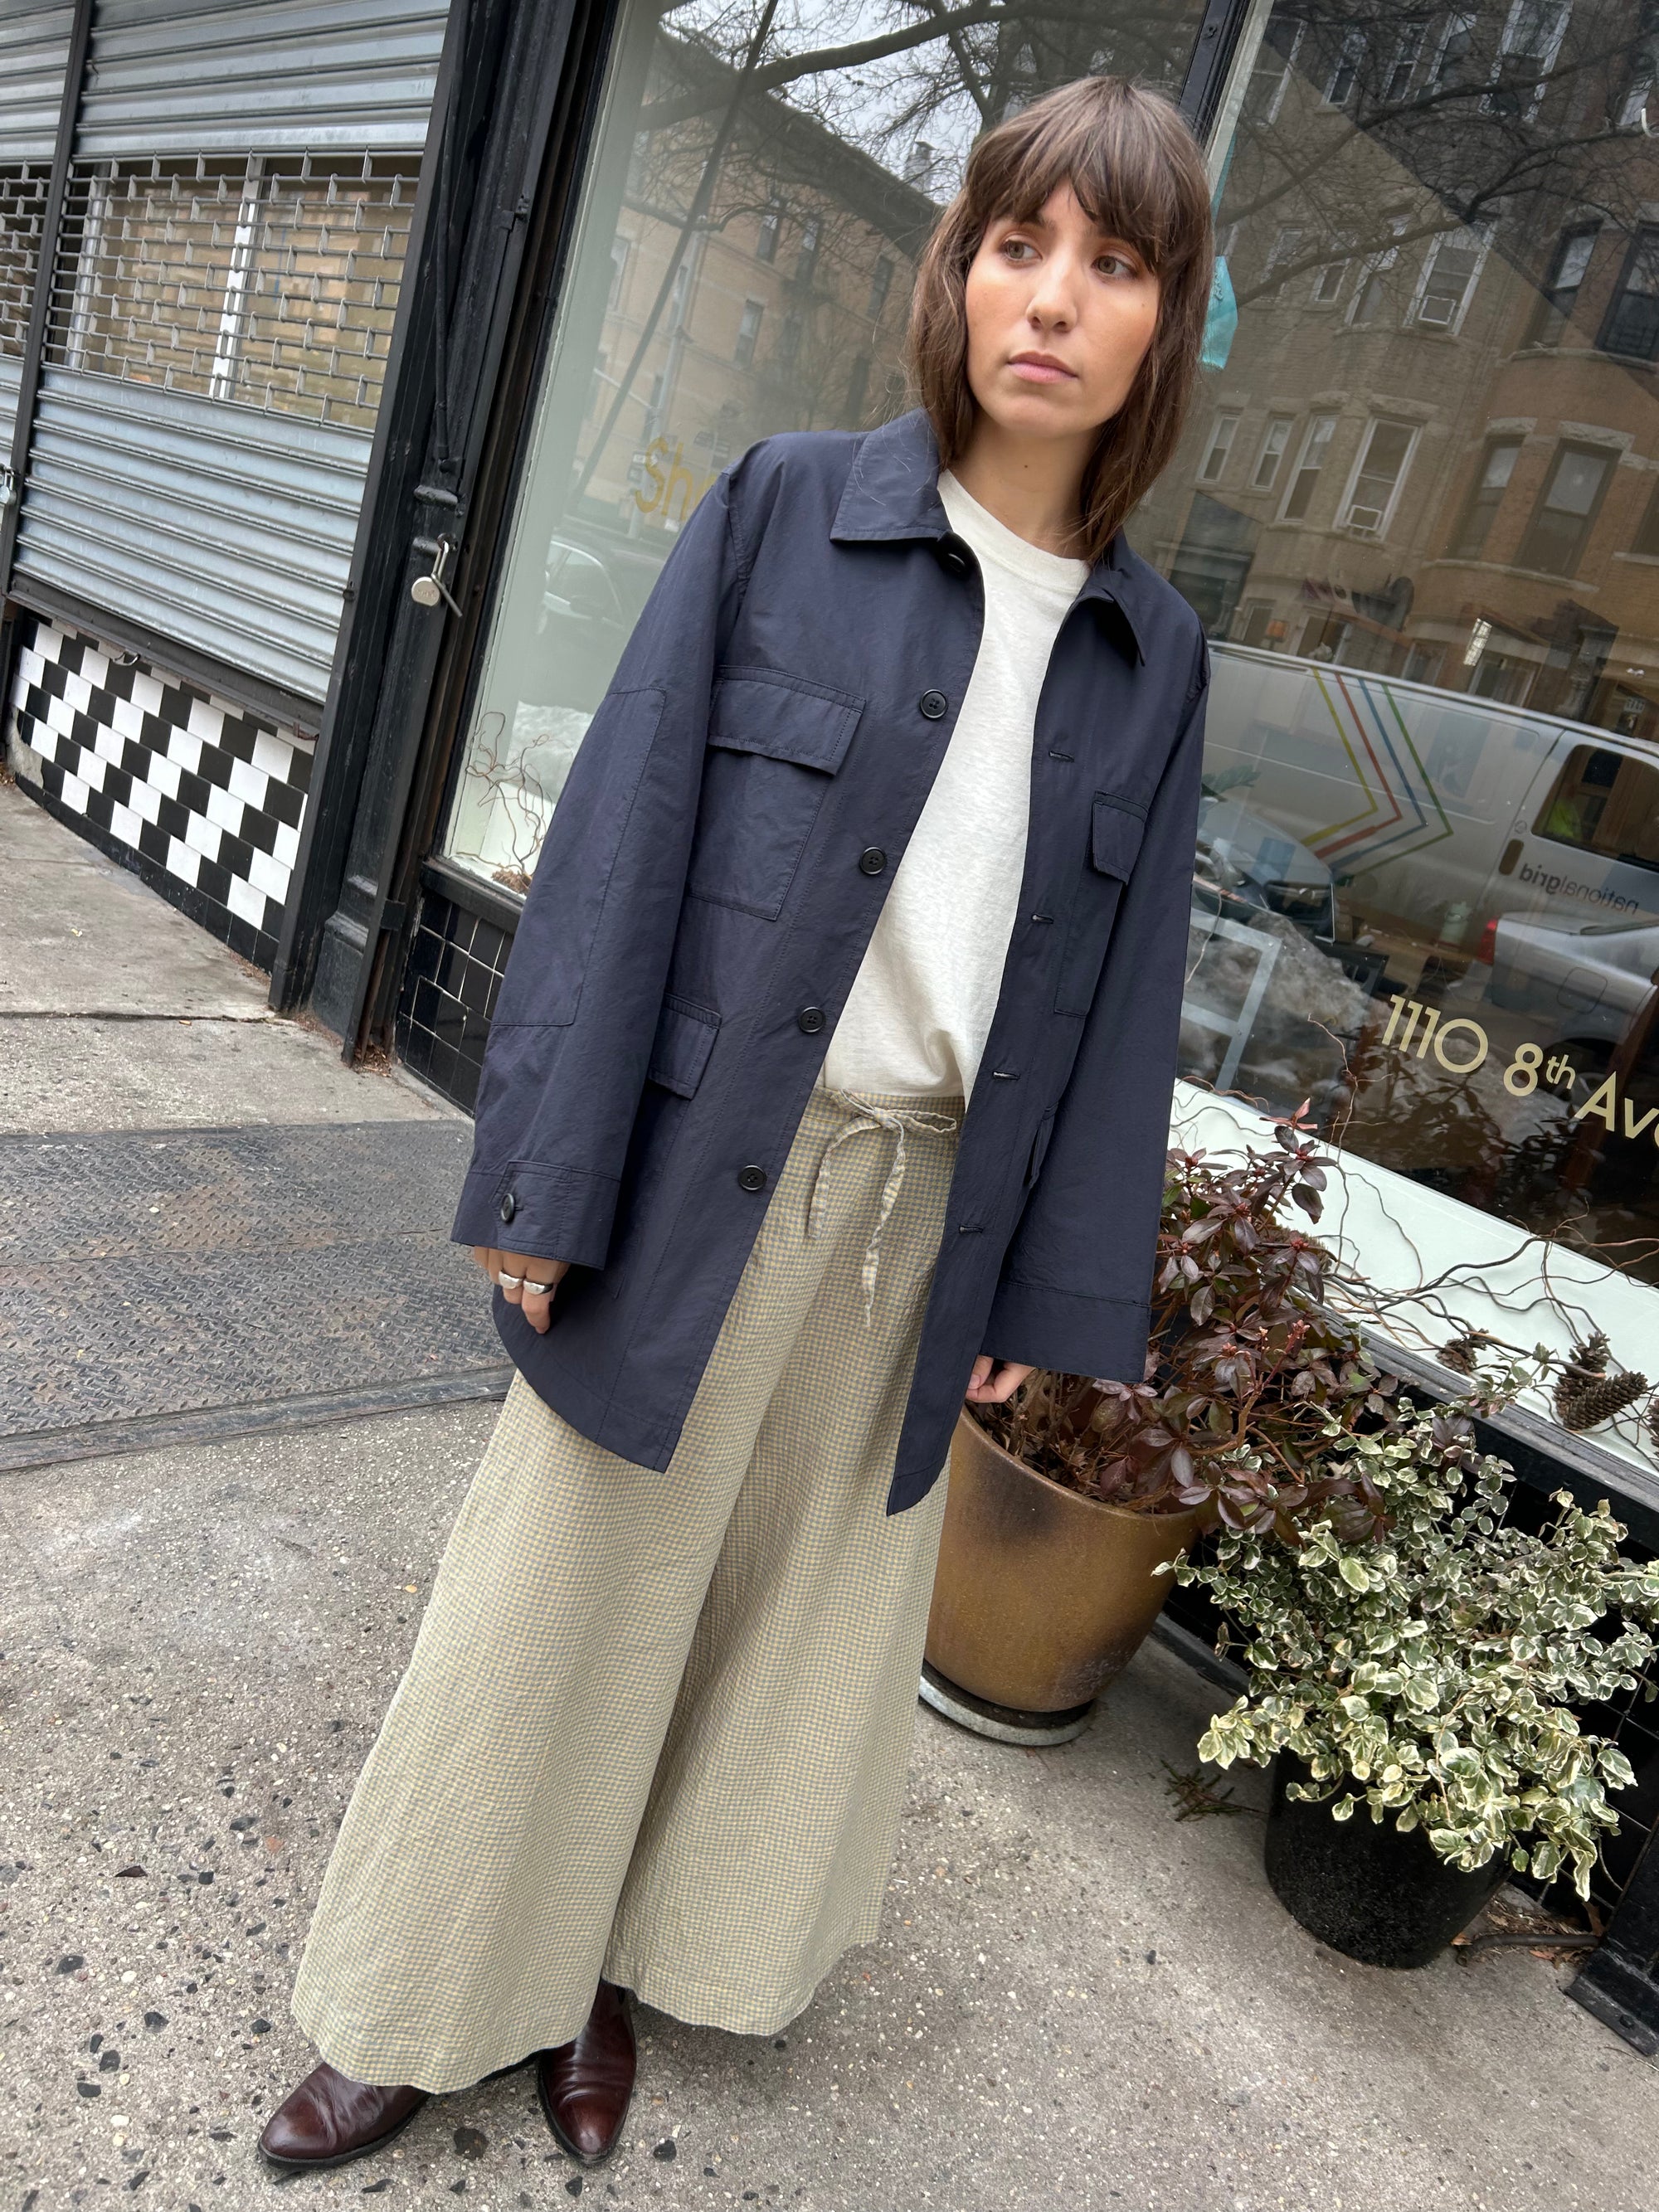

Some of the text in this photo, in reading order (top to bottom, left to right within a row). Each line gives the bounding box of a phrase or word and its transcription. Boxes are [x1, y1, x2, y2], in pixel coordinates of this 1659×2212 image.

[1381, 994, 1659, 1148] 1110 8th Av
